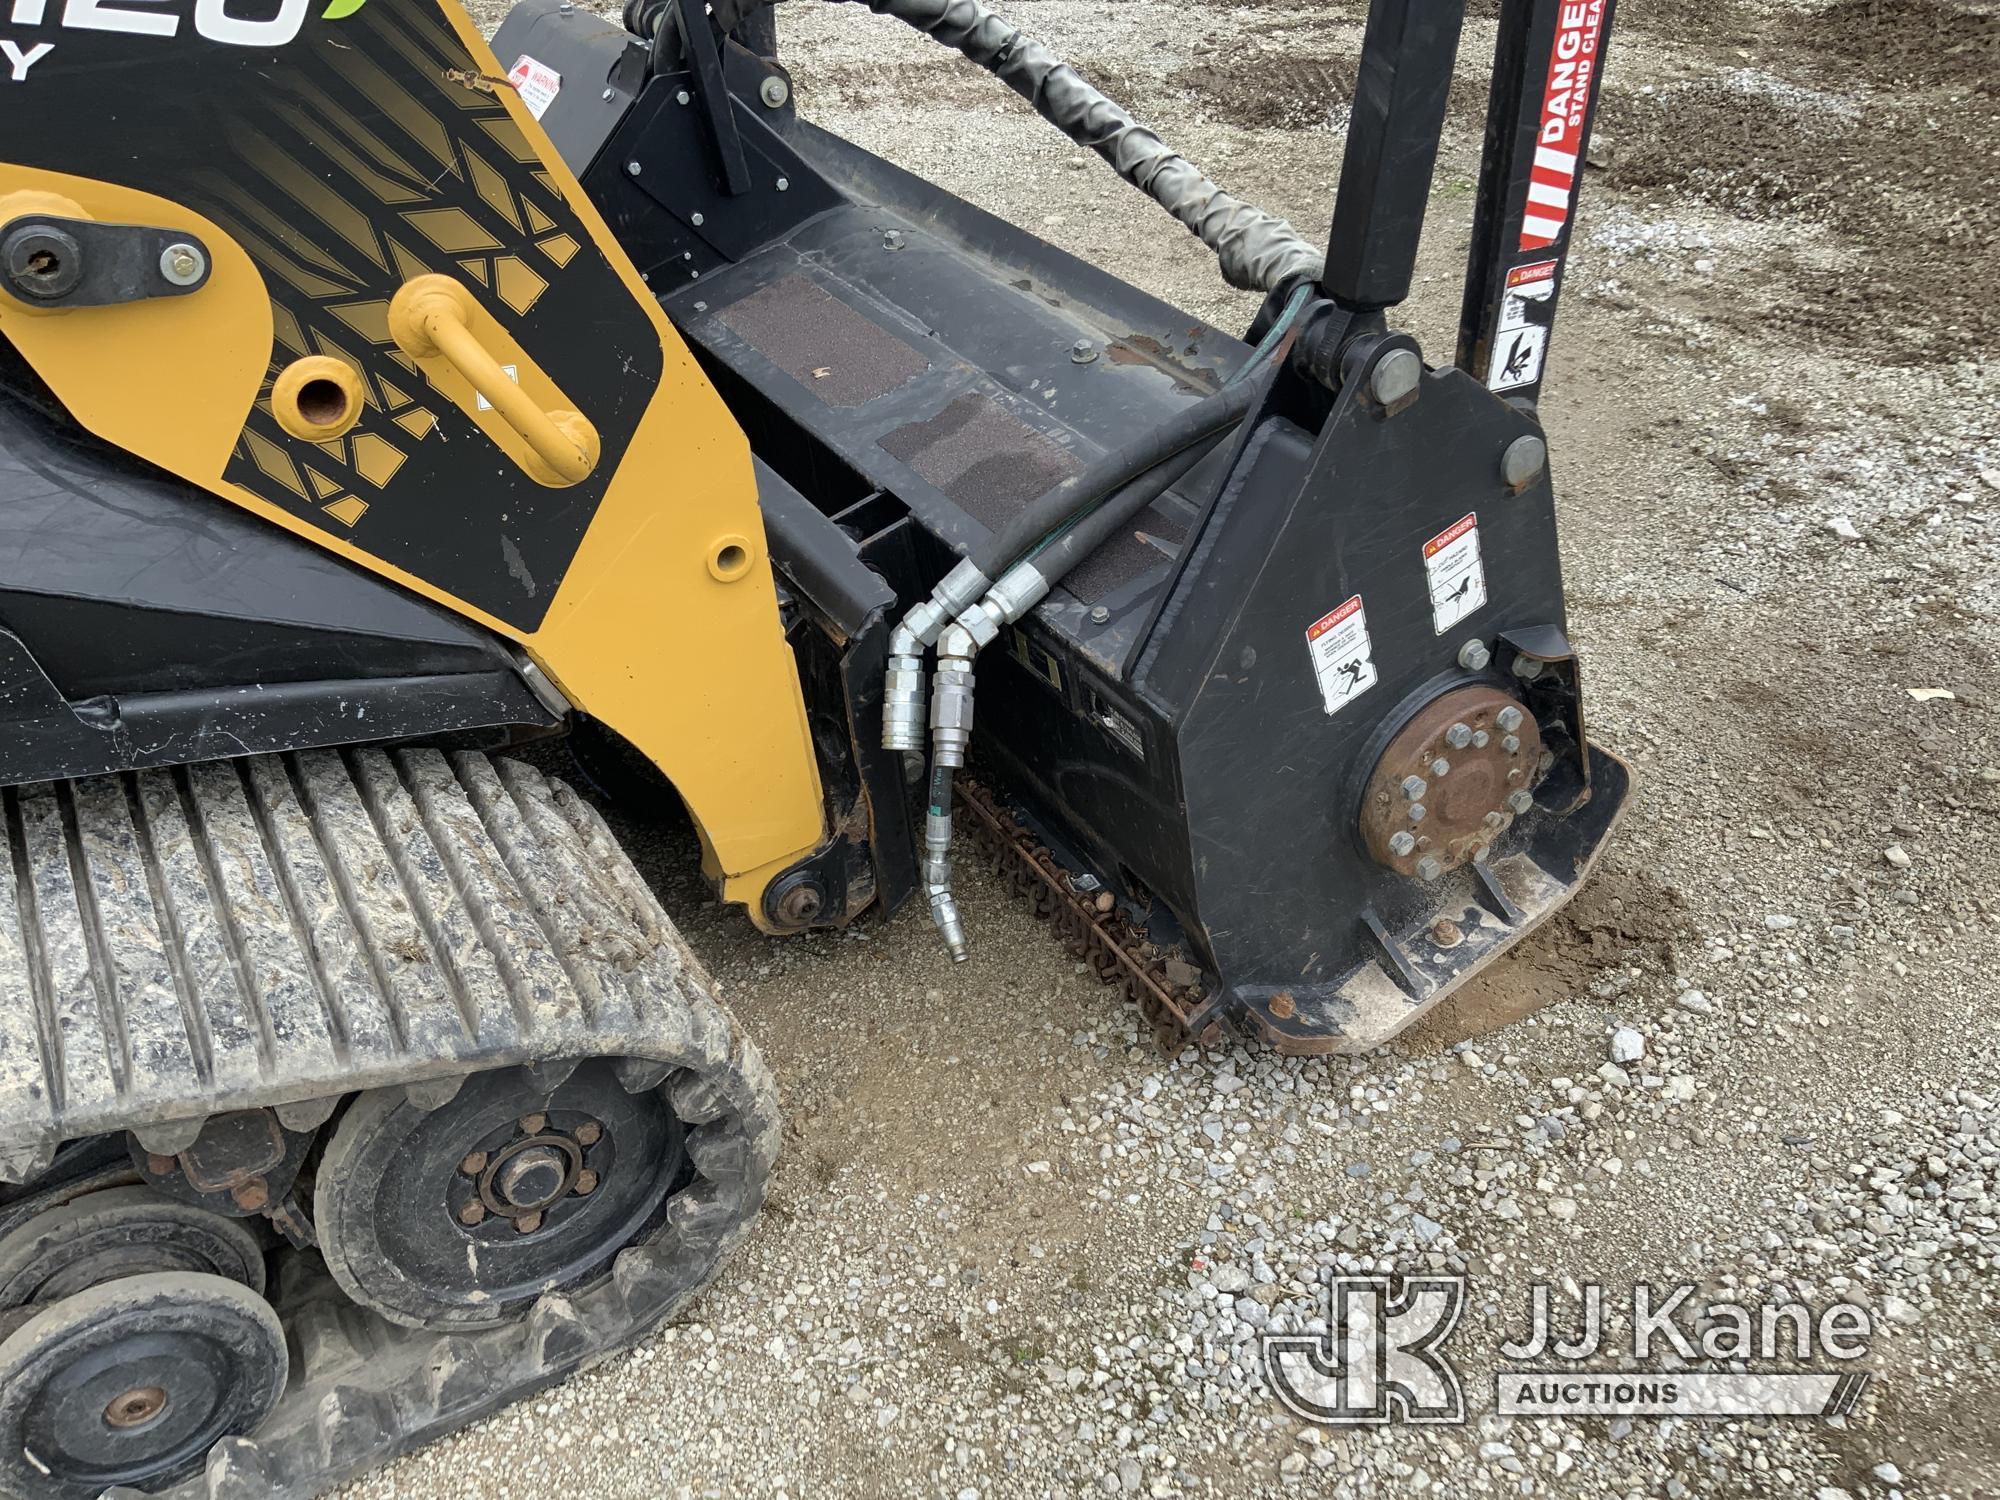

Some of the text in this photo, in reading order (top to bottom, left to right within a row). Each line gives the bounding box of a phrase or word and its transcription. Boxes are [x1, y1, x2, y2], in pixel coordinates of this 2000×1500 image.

[1541, 0, 1588, 144] DANGE
[1568, 0, 1601, 127] STAND CLEA
[1436, 518, 1473, 547] DANGER
[1321, 600, 1358, 630] DANGER
